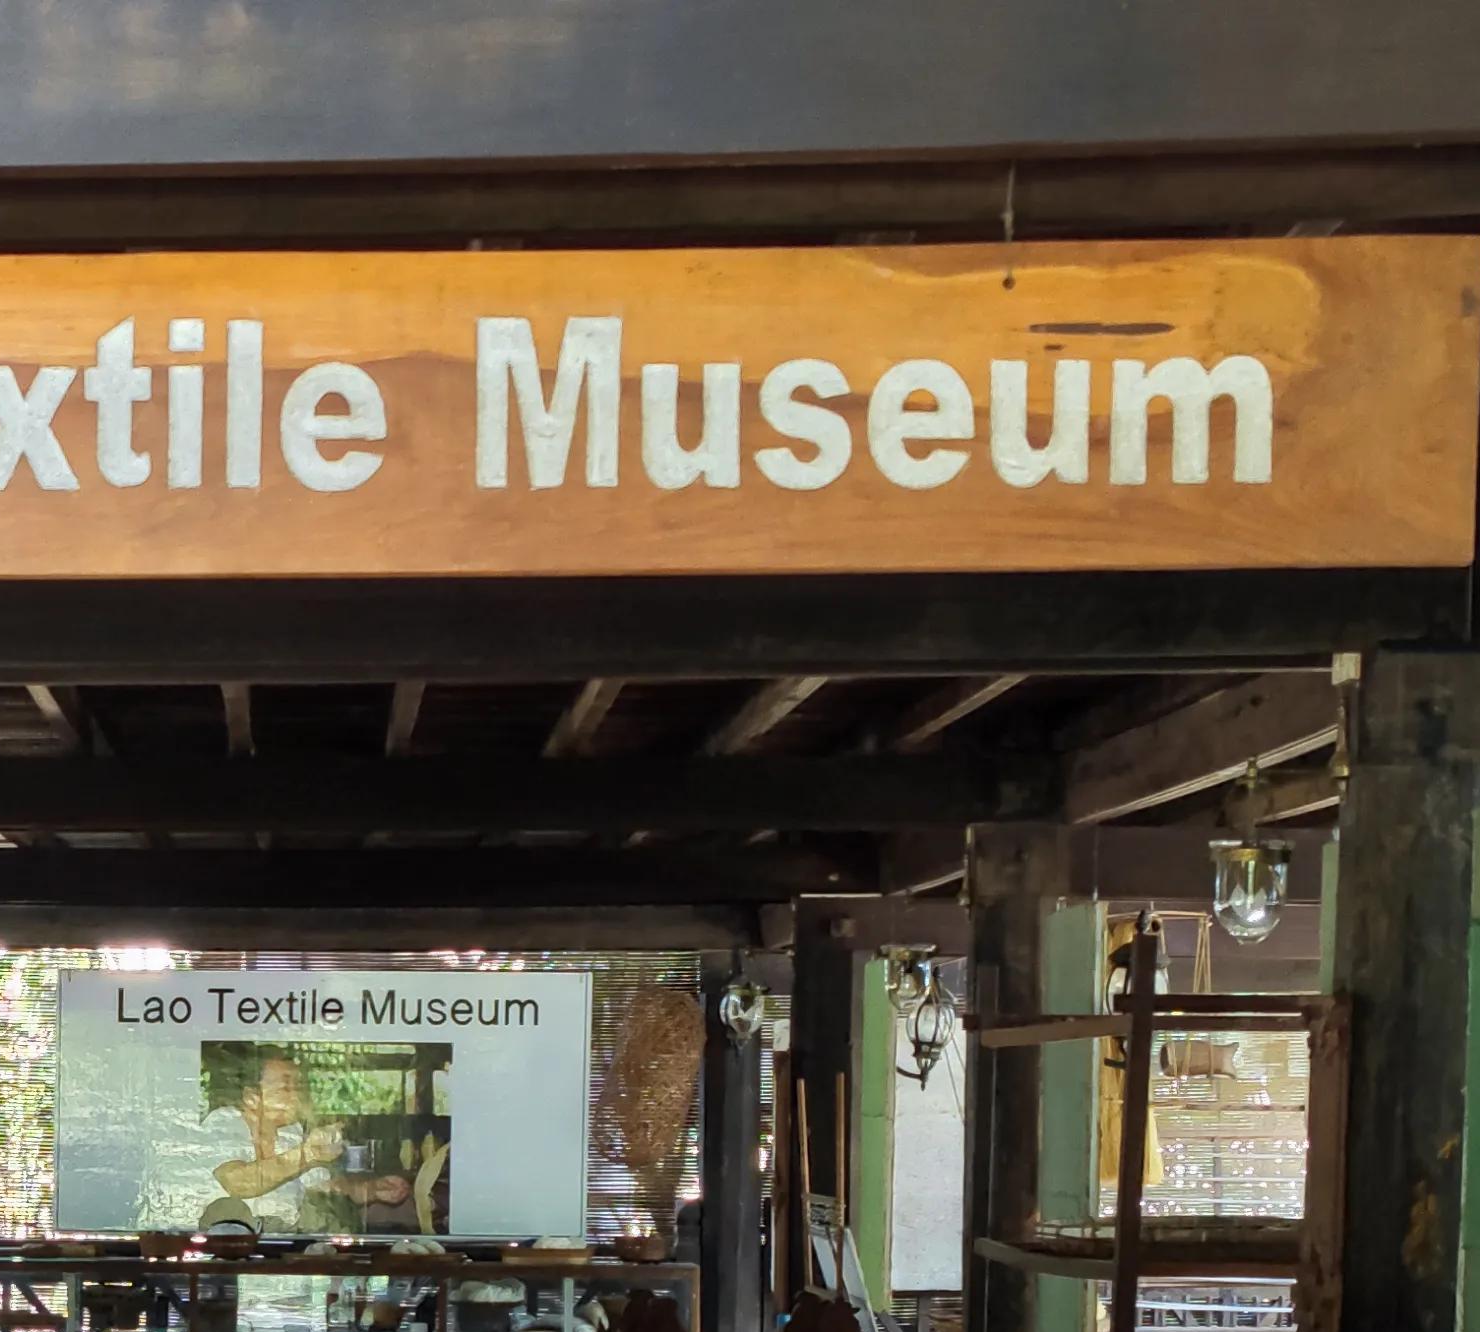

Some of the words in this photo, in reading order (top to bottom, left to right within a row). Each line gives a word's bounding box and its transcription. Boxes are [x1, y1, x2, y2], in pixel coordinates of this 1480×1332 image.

[476, 316, 1272, 489] Museum
[117, 987, 192, 1024] Lao
[208, 988, 344, 1025] Textile
[361, 989, 539, 1026] Museum
